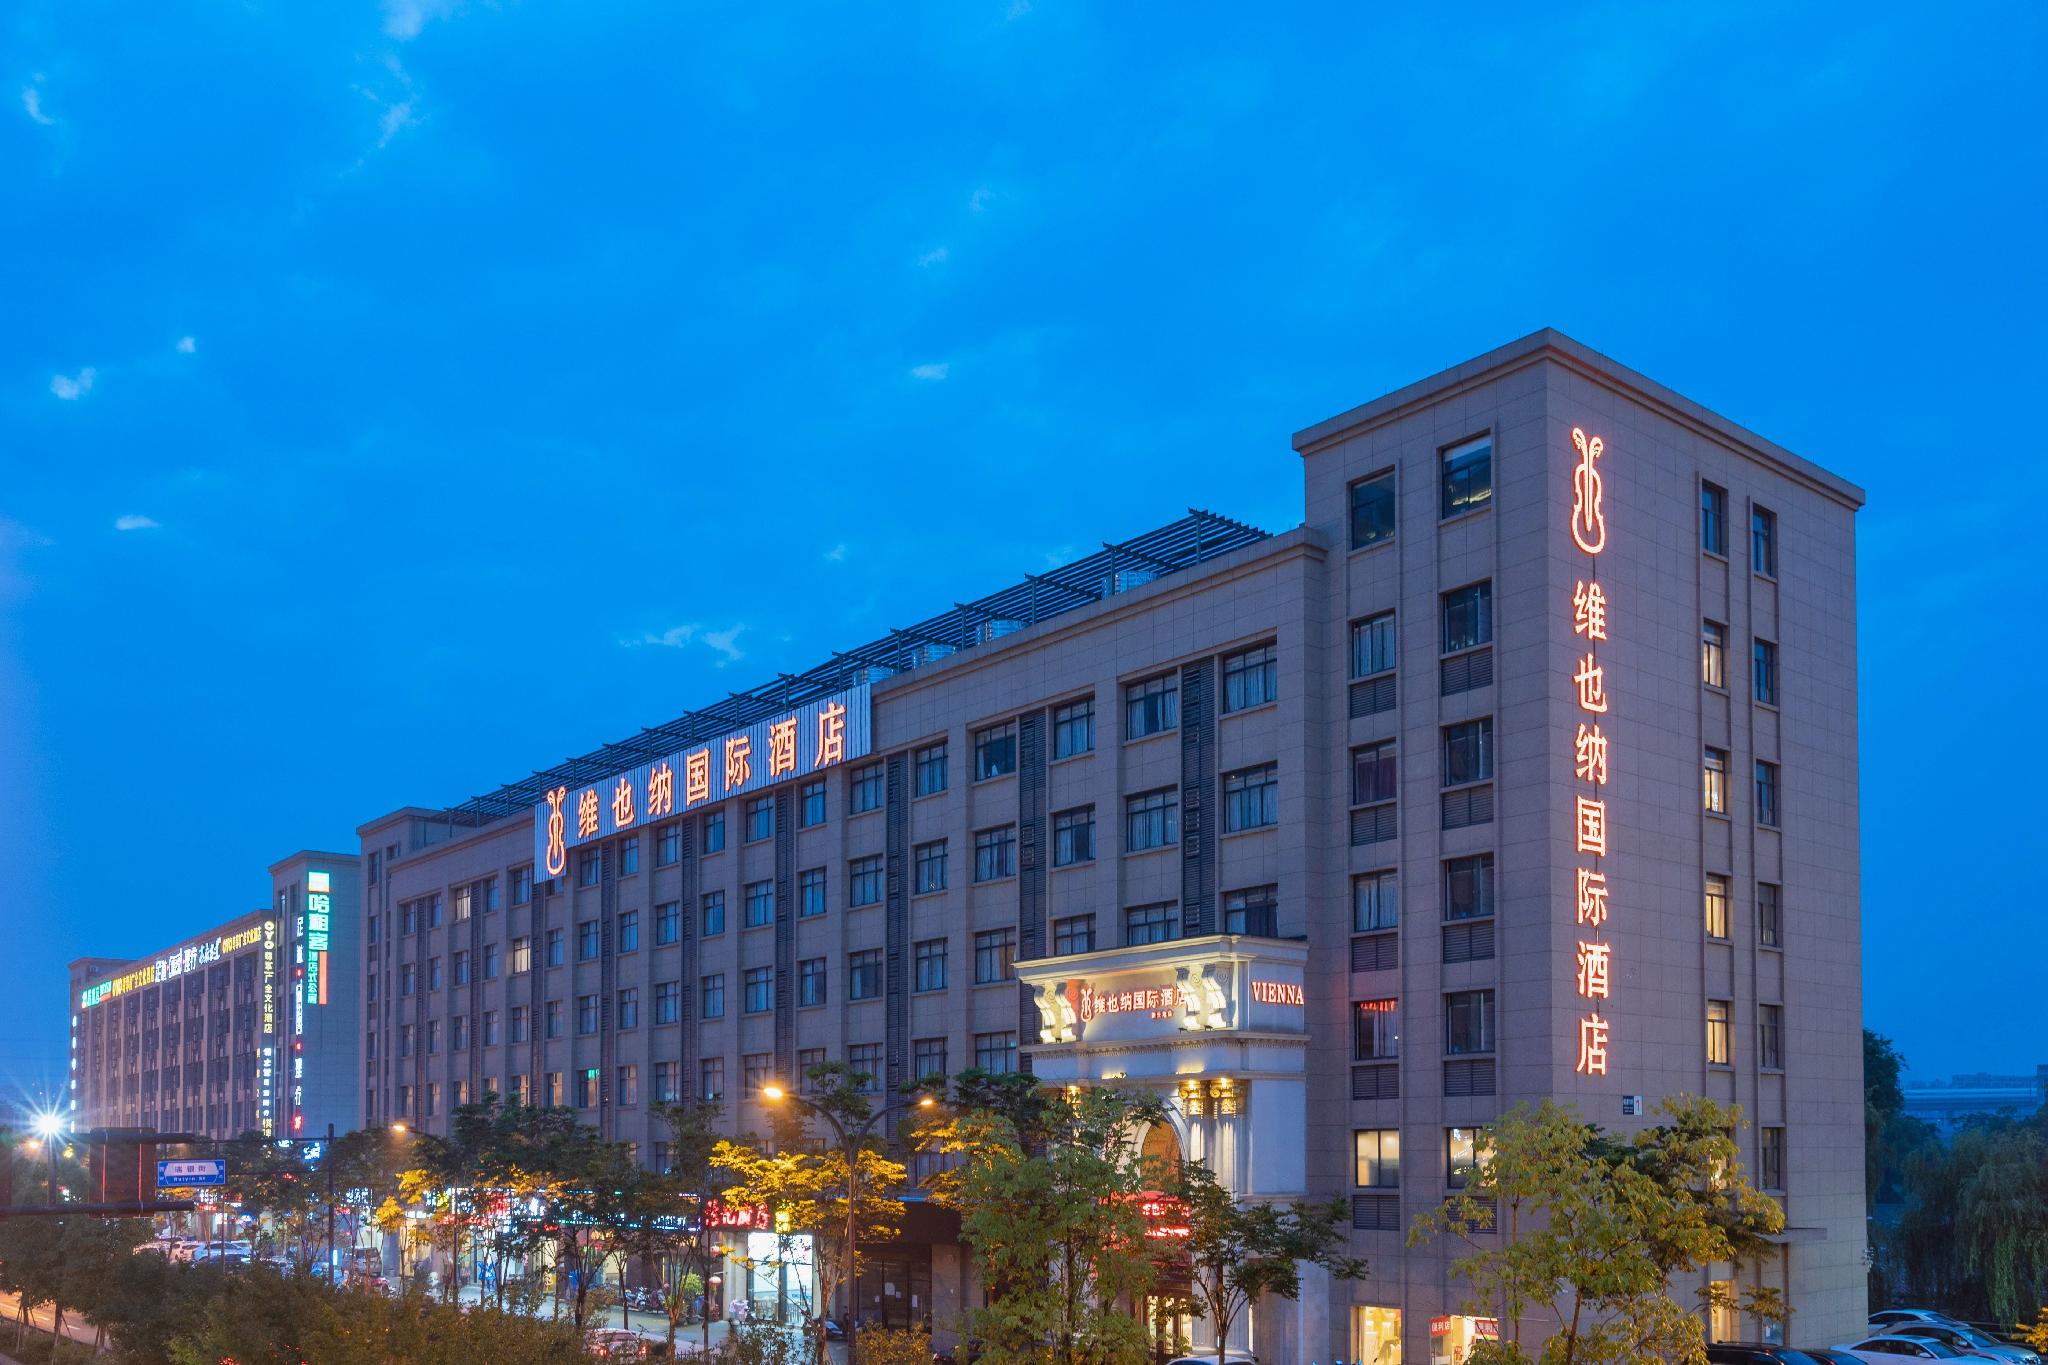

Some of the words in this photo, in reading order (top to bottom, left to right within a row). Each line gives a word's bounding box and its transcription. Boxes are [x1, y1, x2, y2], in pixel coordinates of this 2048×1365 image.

[577, 702, 847, 839] 维也纳国际酒店
[1573, 580, 1610, 1075] 维也纳国际酒店
[1251, 981, 1305, 1006] VIENNA
